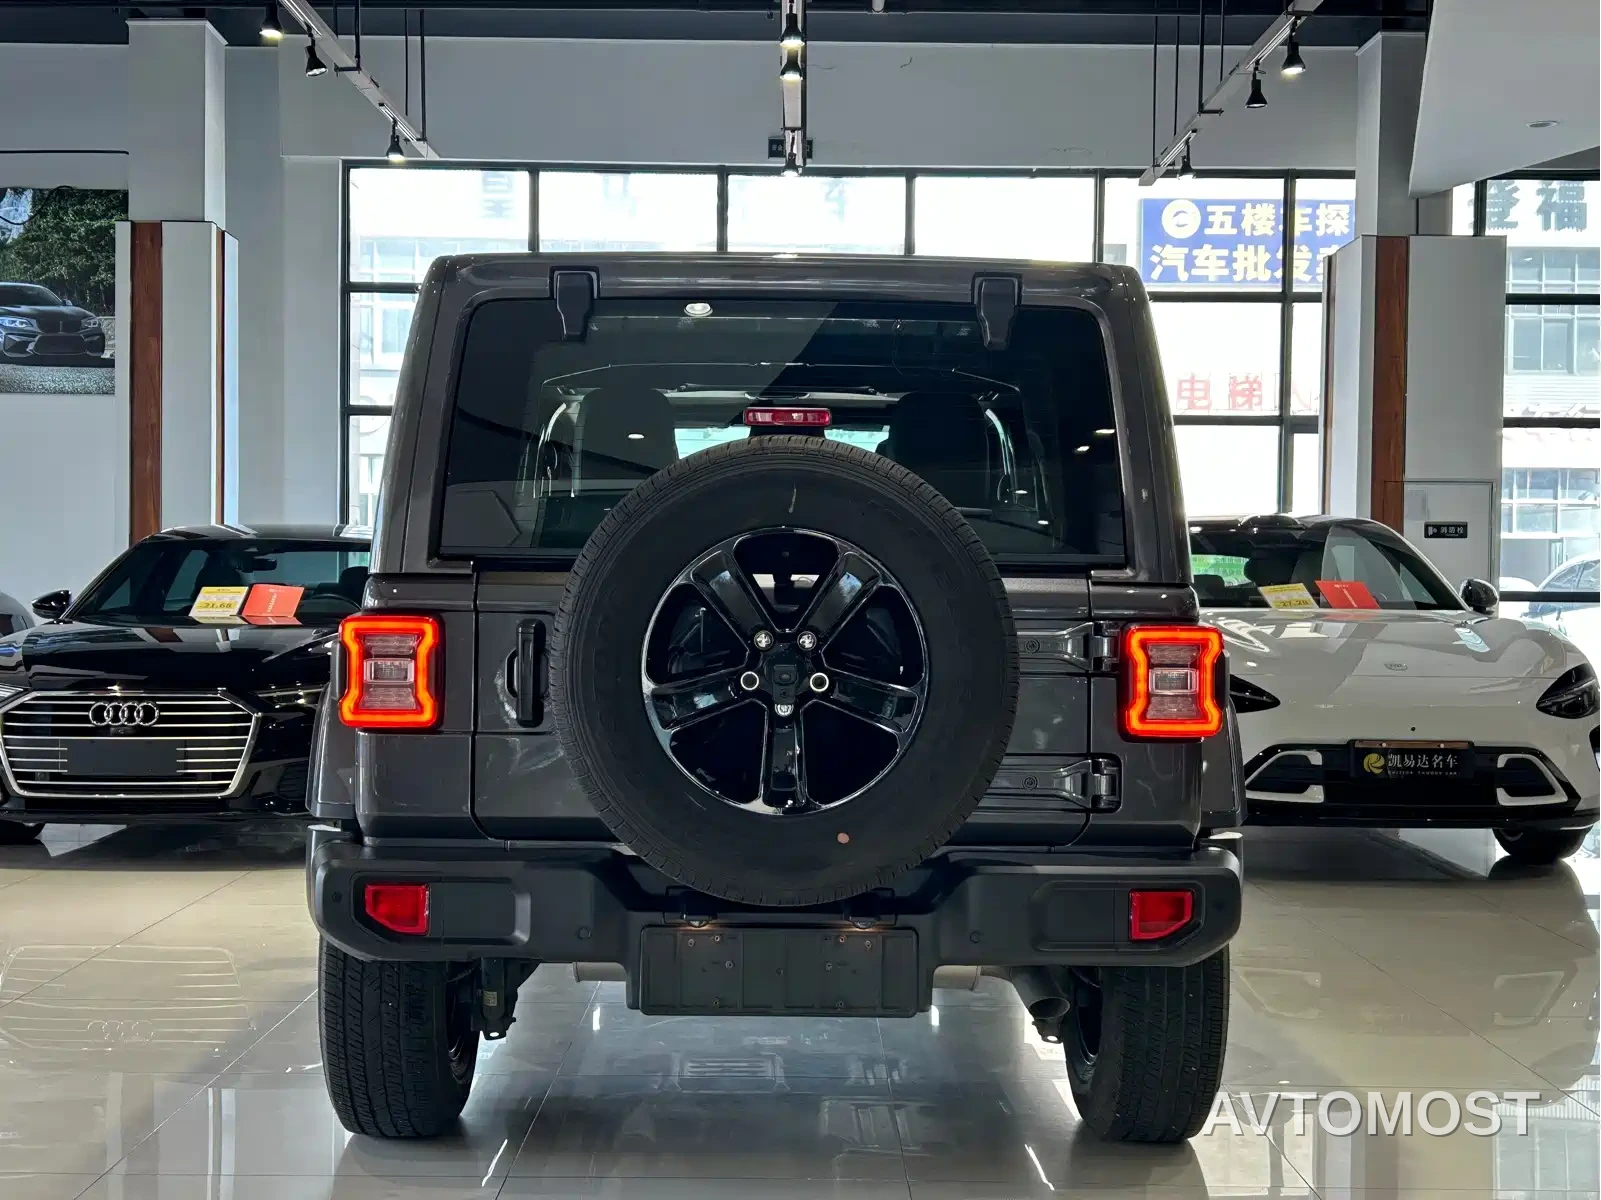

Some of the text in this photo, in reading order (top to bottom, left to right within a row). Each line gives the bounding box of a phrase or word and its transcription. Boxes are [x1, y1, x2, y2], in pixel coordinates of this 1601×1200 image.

[1387, 753, 1458, 769] 凯易达名车
